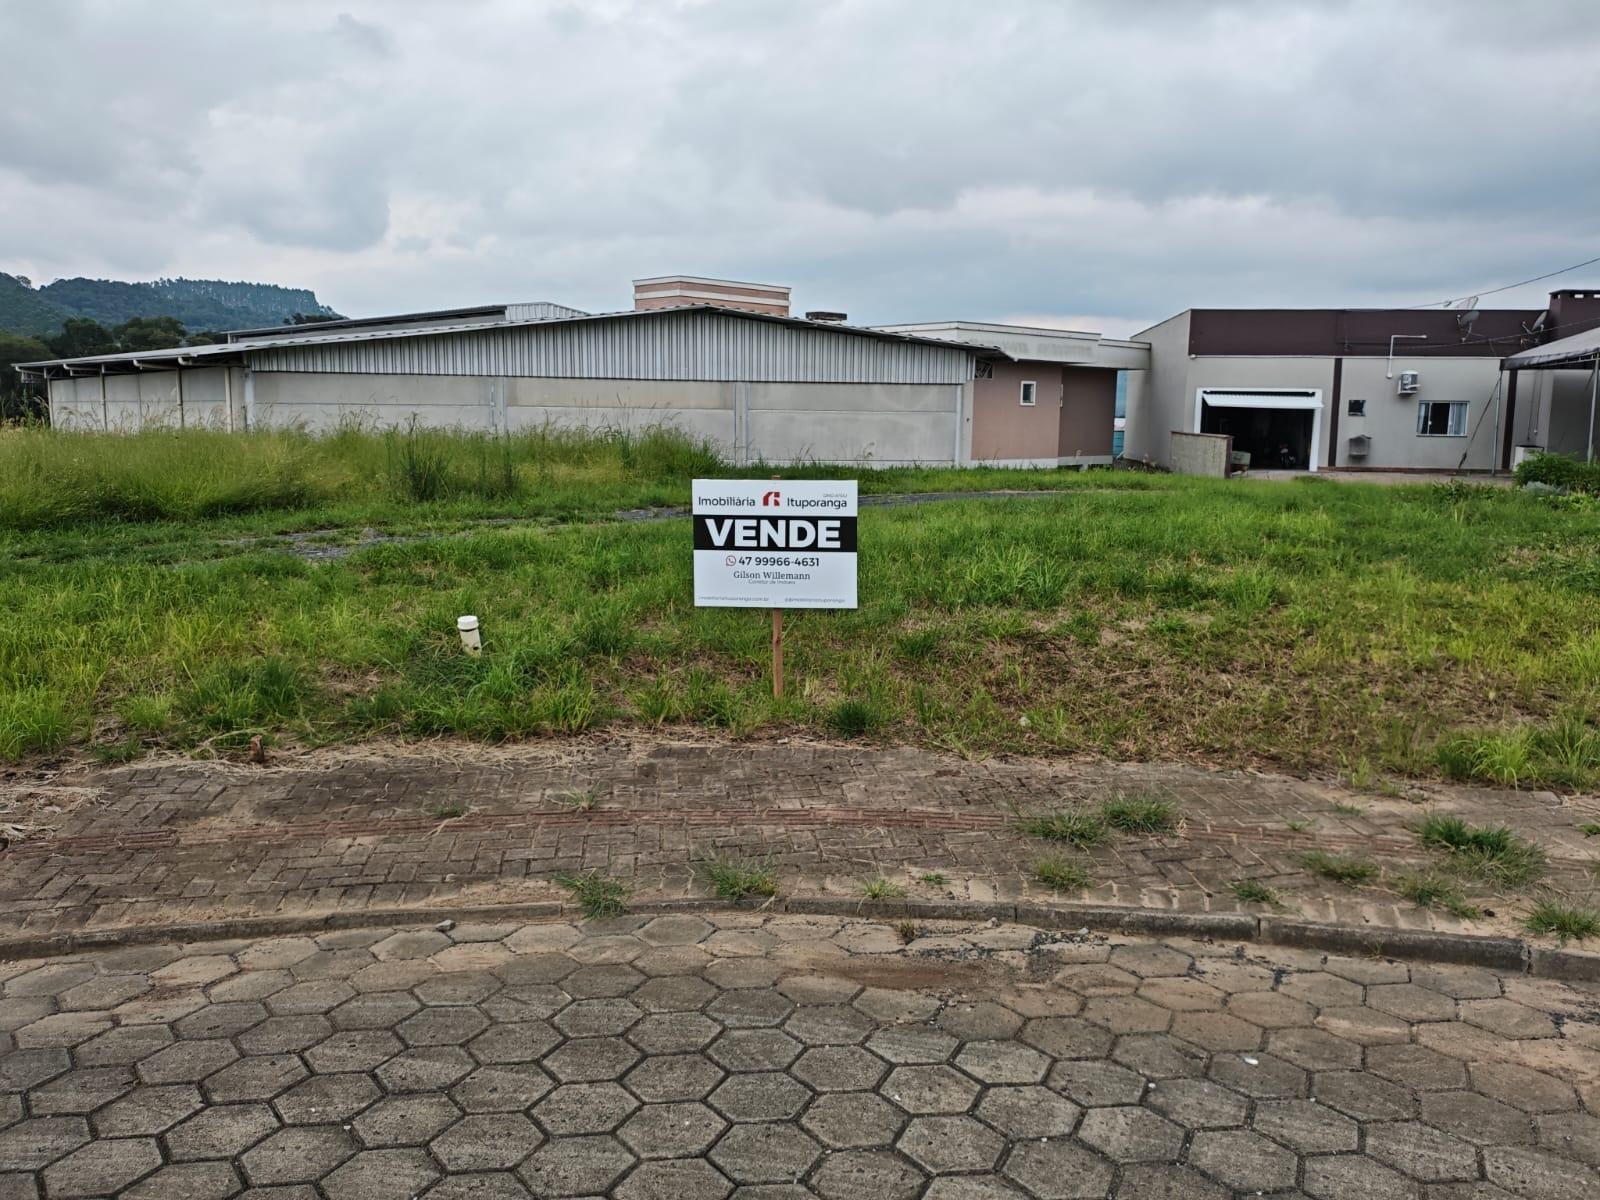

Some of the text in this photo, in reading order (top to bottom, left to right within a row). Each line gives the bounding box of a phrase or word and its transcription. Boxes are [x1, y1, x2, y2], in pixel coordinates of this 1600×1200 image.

[698, 496, 848, 510] Imobiliária Ituporanga
[704, 518, 841, 549] VENDE
[738, 556, 820, 567] 47 99966-4631
[733, 570, 811, 580] Gilson Willemann
